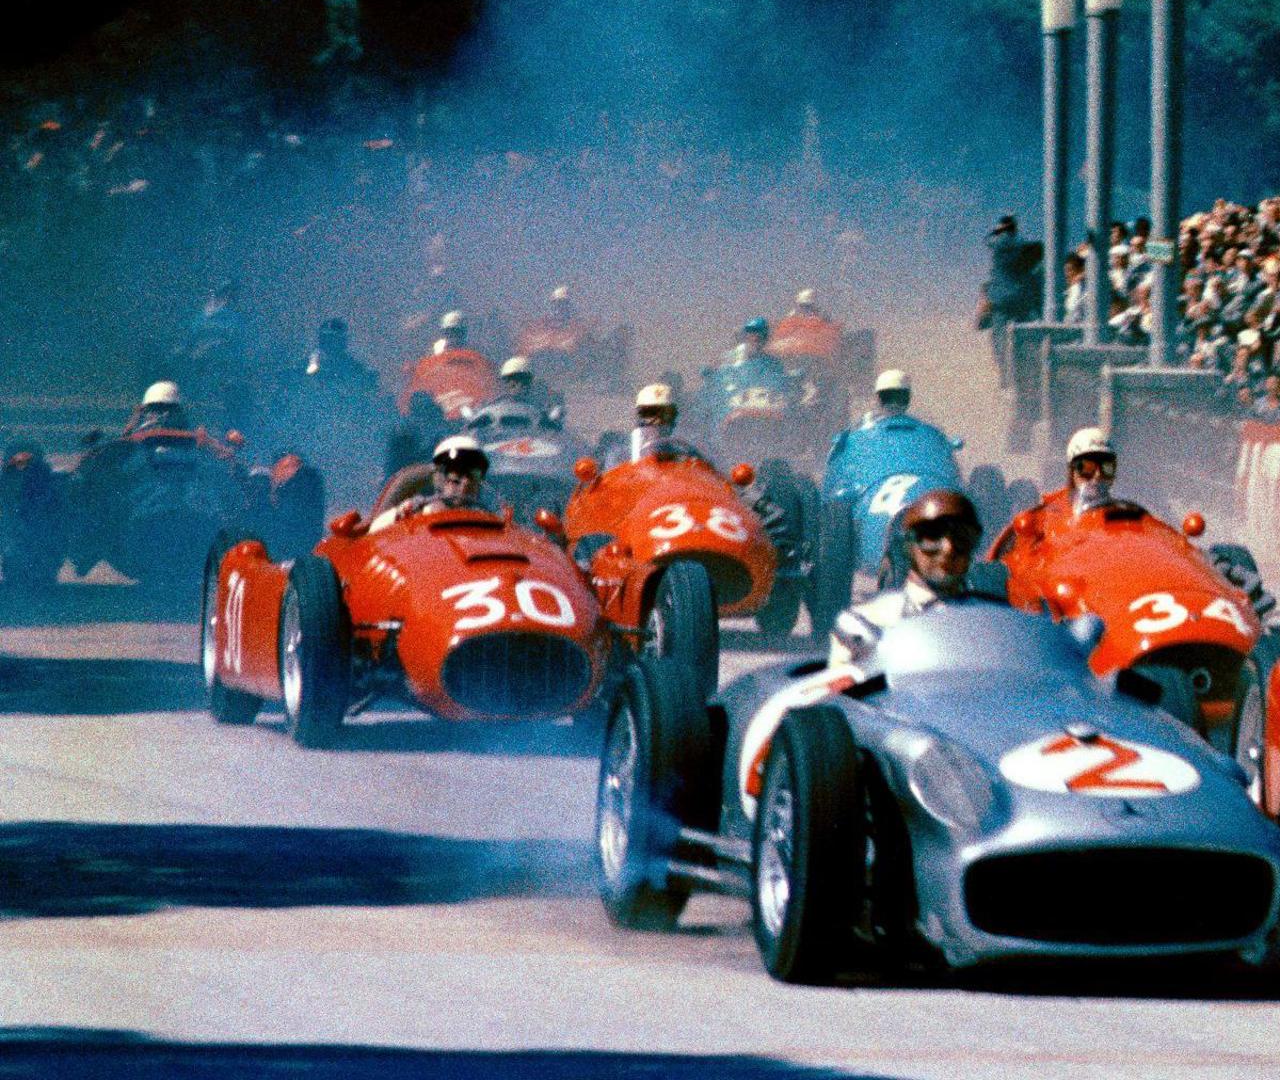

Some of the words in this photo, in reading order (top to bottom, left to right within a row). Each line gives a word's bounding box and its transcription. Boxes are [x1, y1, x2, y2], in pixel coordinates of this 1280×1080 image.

[649, 503, 748, 542] 38
[441, 576, 576, 631] 30
[1128, 592, 1252, 636] 34
[1040, 733, 1168, 791] 2
